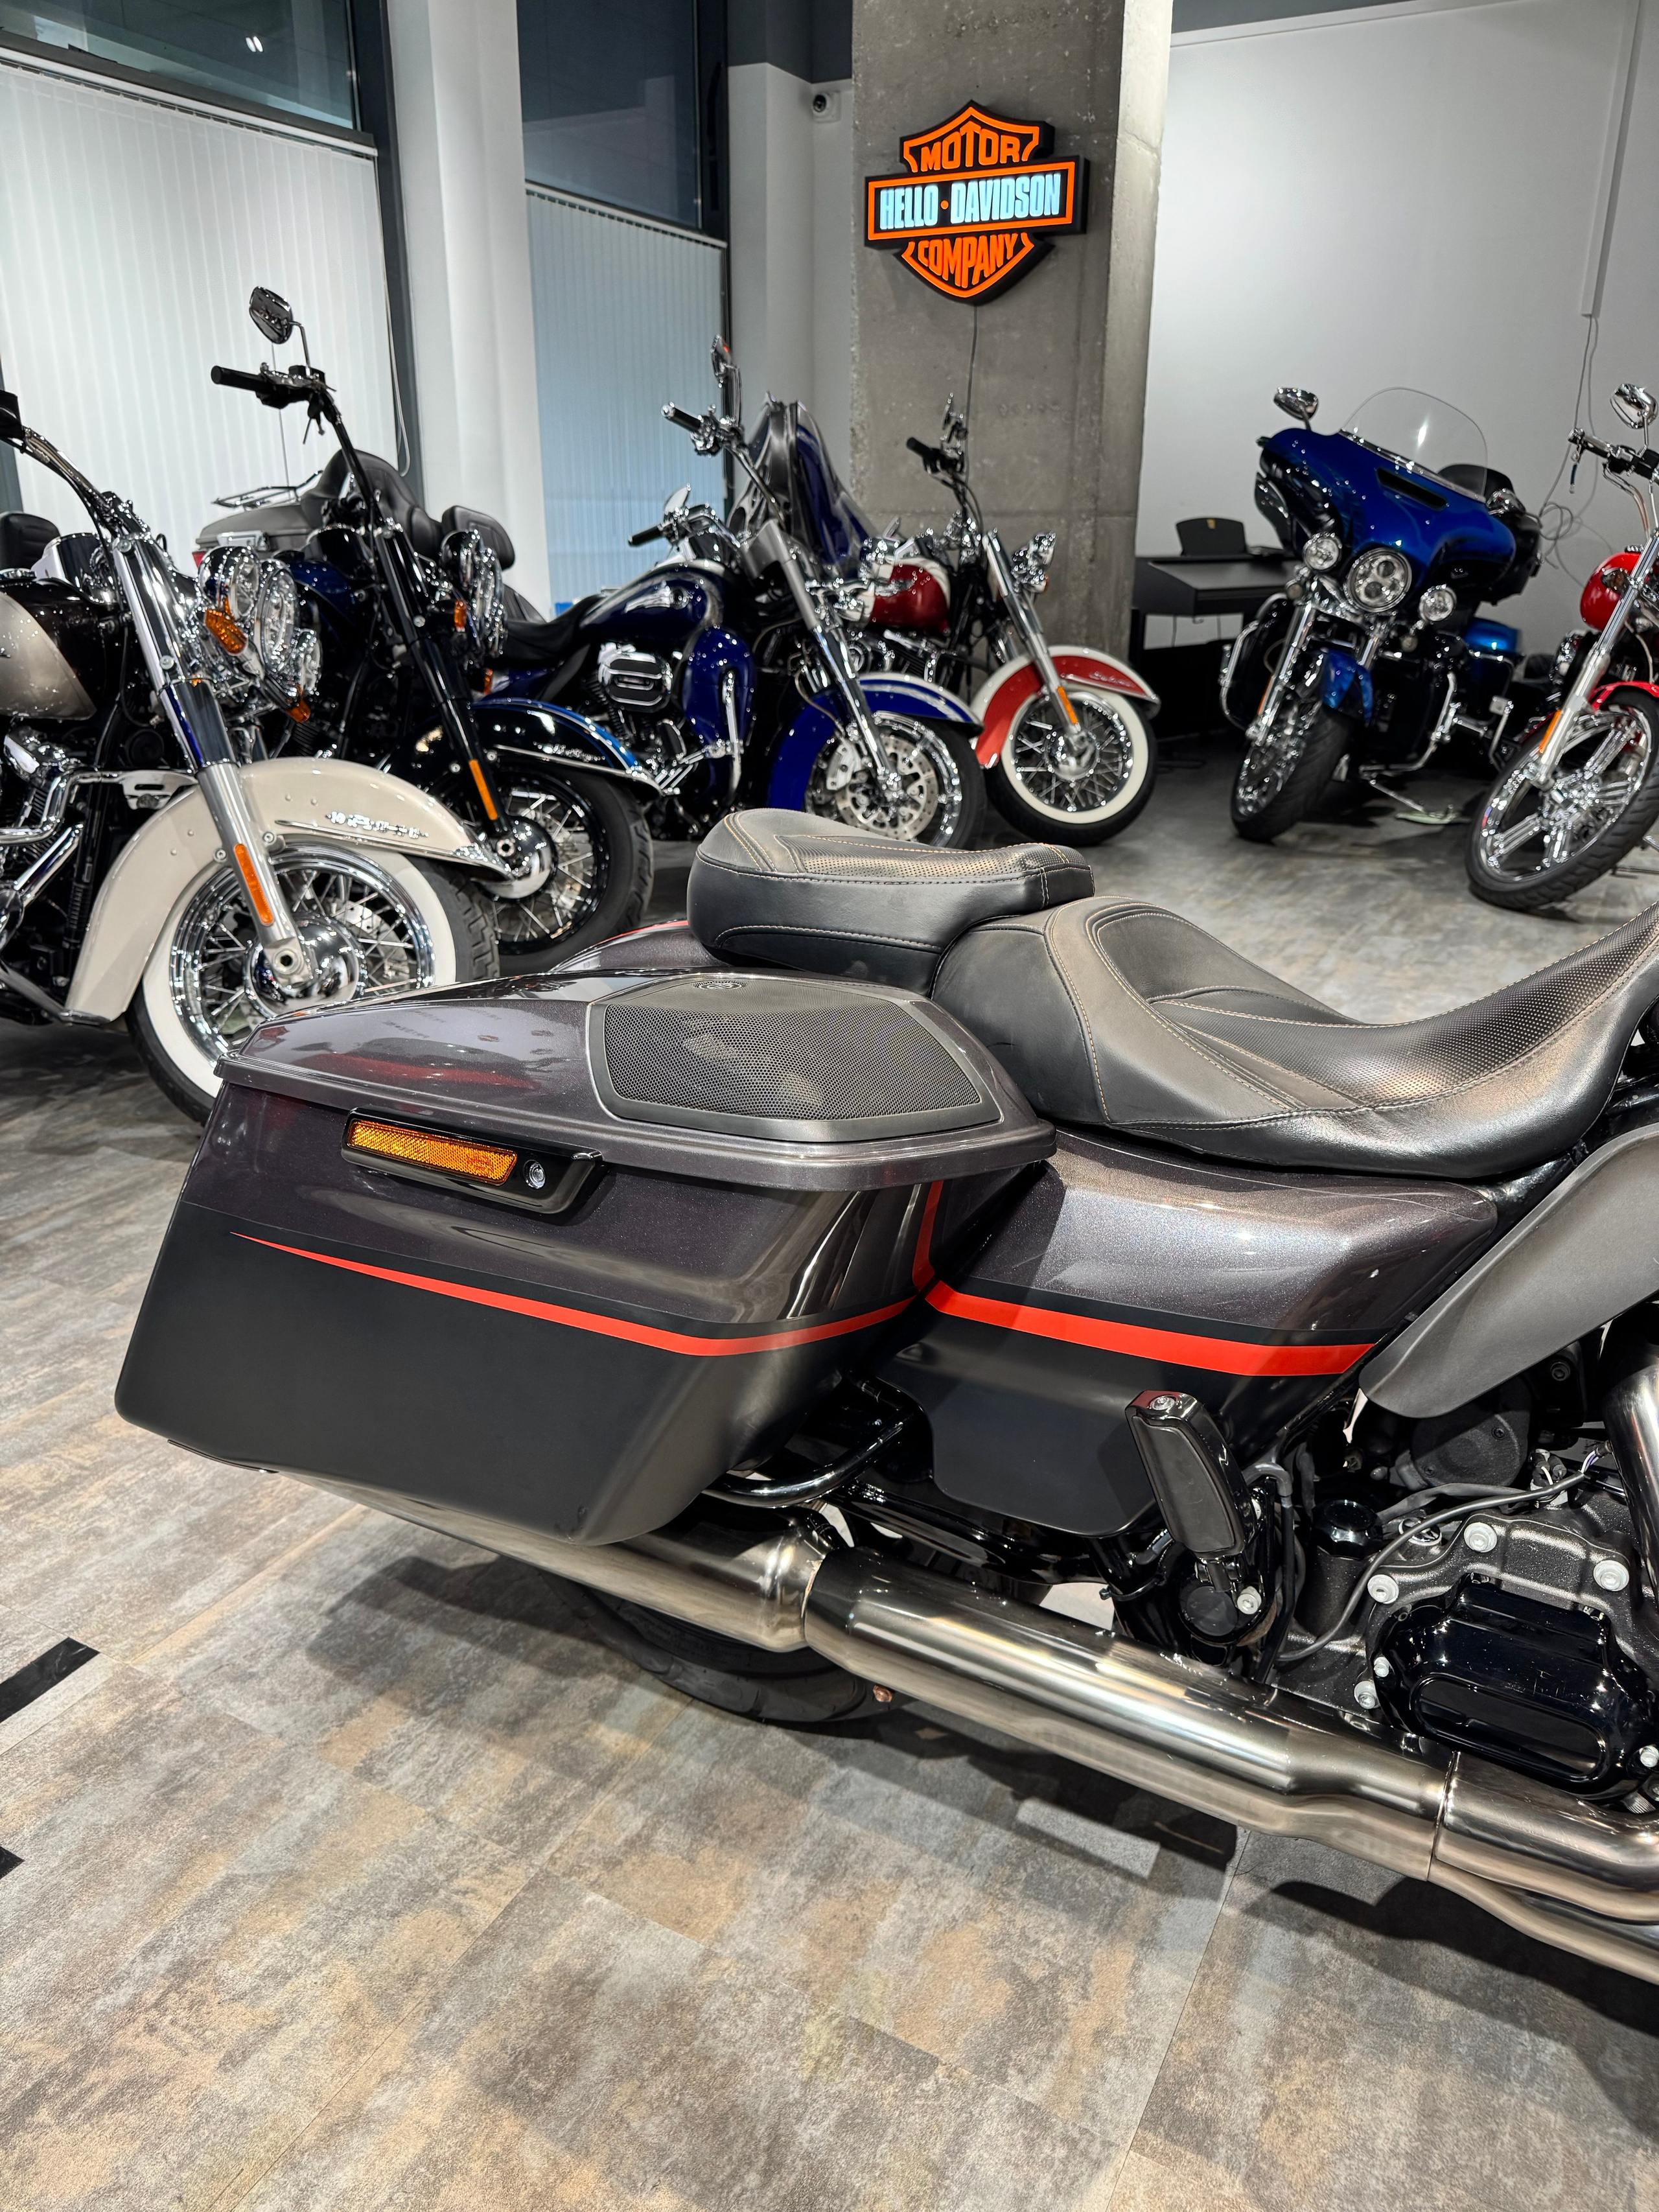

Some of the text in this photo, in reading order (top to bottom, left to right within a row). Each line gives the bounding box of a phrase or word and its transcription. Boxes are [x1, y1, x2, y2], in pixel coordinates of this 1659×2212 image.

[920, 121, 1020, 172] MOTOR
[880, 173, 1062, 230] HELLO DAVIDSON
[918, 232, 1019, 288] COMPANY
